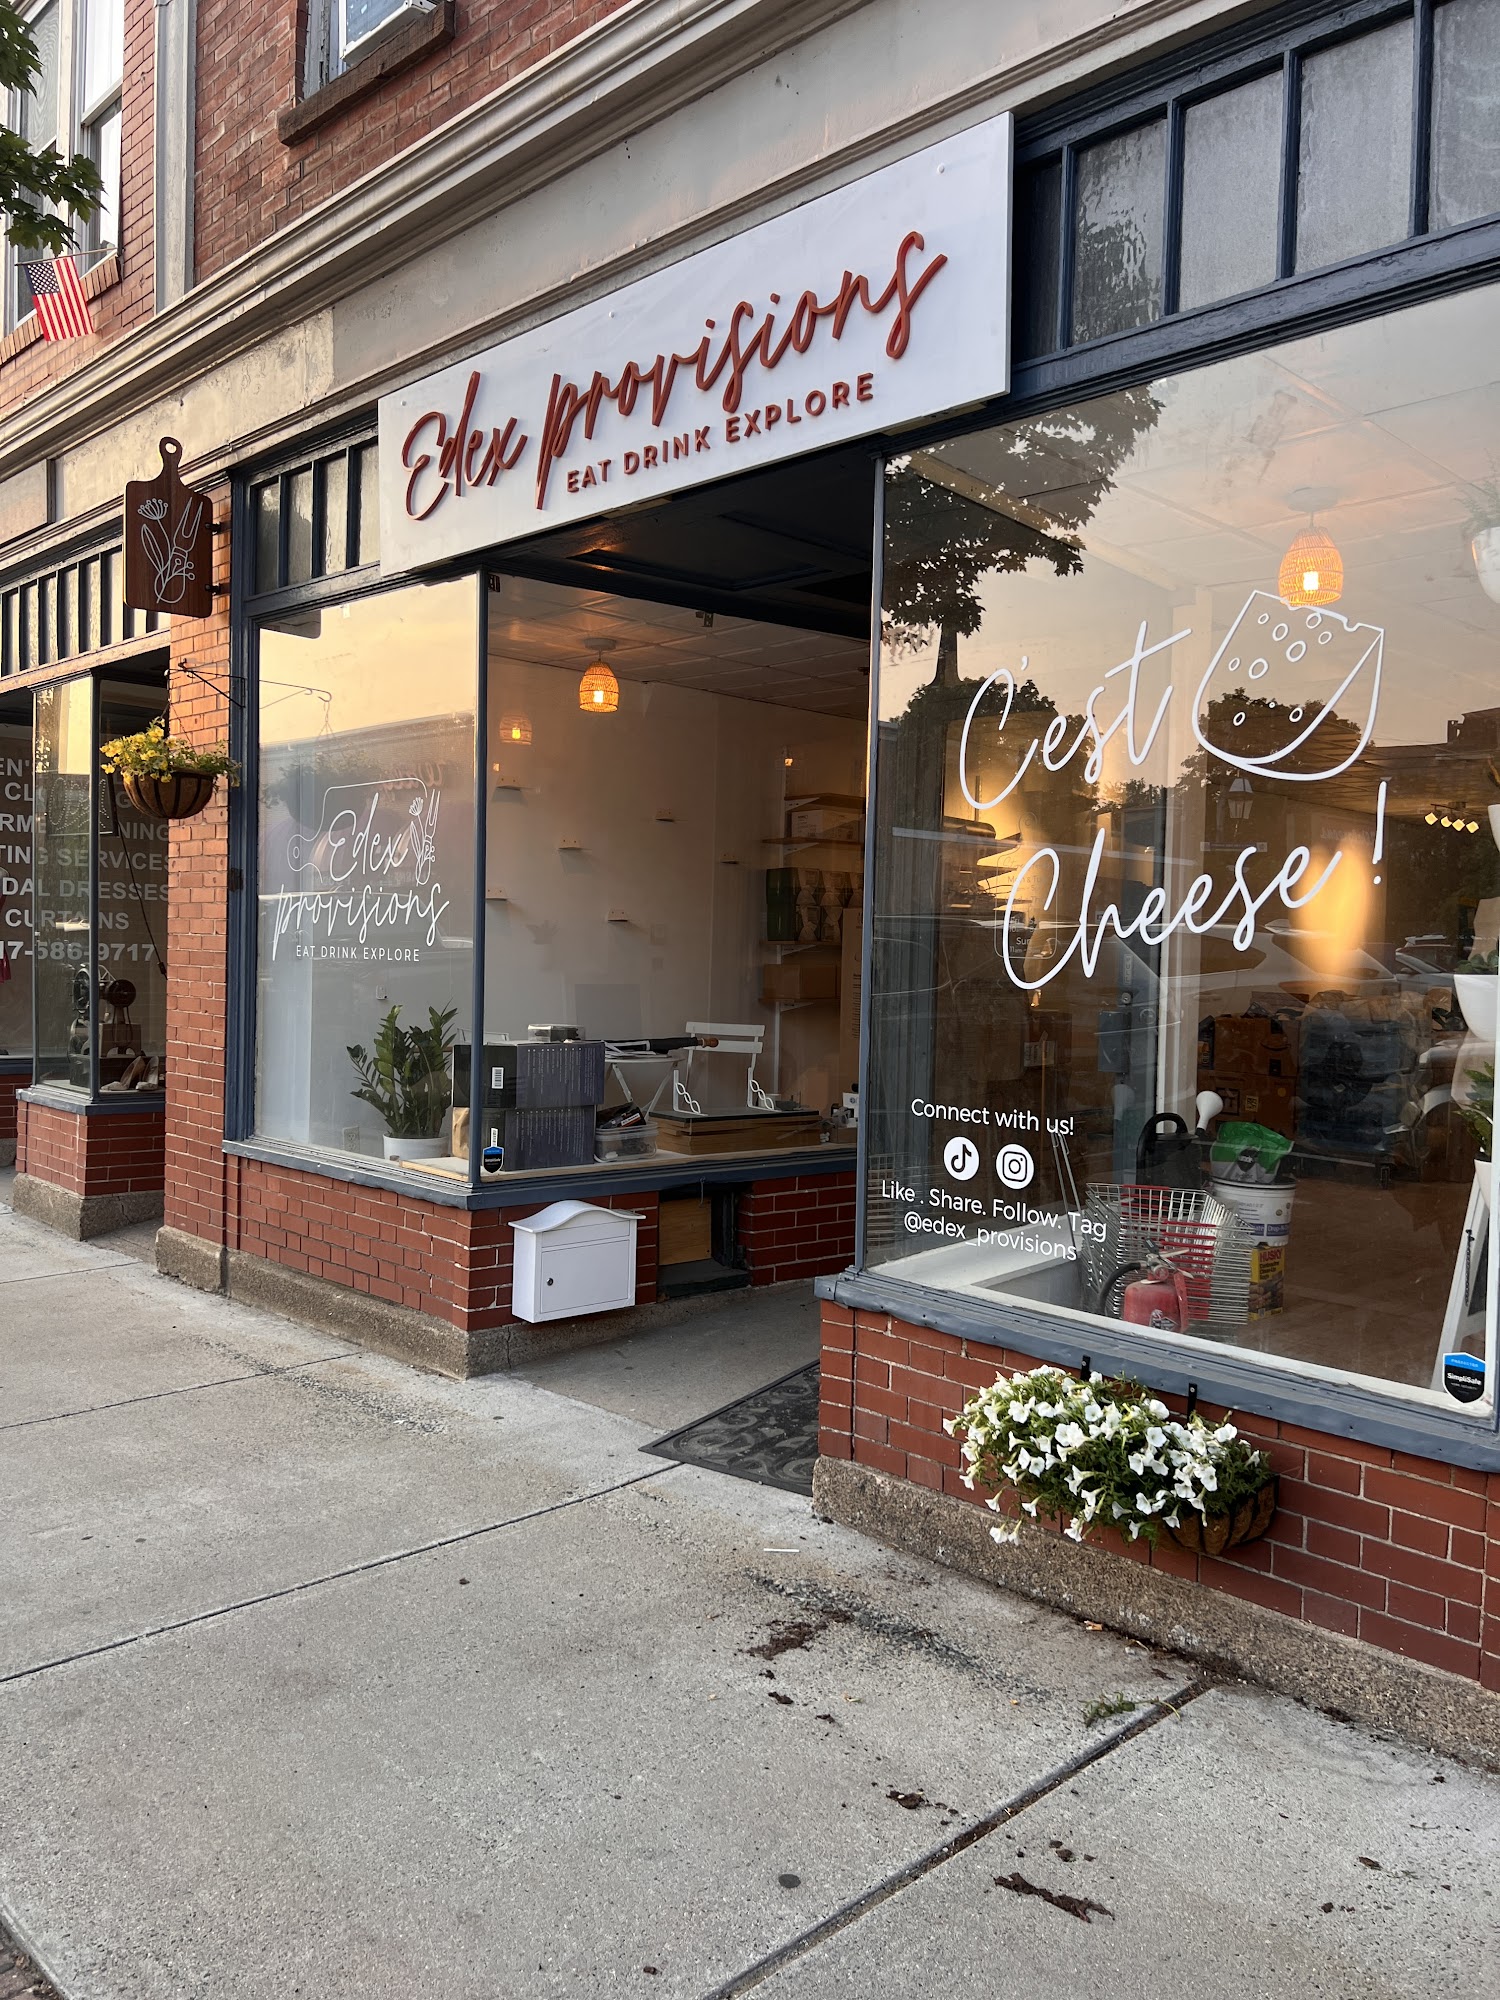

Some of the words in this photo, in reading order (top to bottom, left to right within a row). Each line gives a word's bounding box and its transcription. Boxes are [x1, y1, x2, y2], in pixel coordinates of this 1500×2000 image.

[402, 371, 528, 521] Edex
[535, 231, 948, 510] provisions
[567, 459, 612, 493] EAT
[624, 426, 710, 475] DRINK
[725, 373, 874, 443] EXPLORE
[960, 621, 1192, 810] C'est
[57, 848, 169, 871] SERVICE
[328, 792, 409, 881] Edex
[5, 909, 130, 930] CURTANS
[272, 883, 450, 961] provisions
[296, 945, 316, 957] EAT
[321, 946, 358, 959] DRINK
[363, 948, 420, 962] EXPLORE
[911, 1098, 990, 1125] Connect
[995, 1109, 1040, 1131] with
[1046, 1117, 1075, 1136] us!
[882, 1179, 916, 1203] Like
[929, 1188, 987, 1216] Share.
[992, 1198, 1061, 1230] Follow.
[1067, 1211, 1107, 1243] Tag
[904, 1211, 1077, 1262] @edex_provisions
